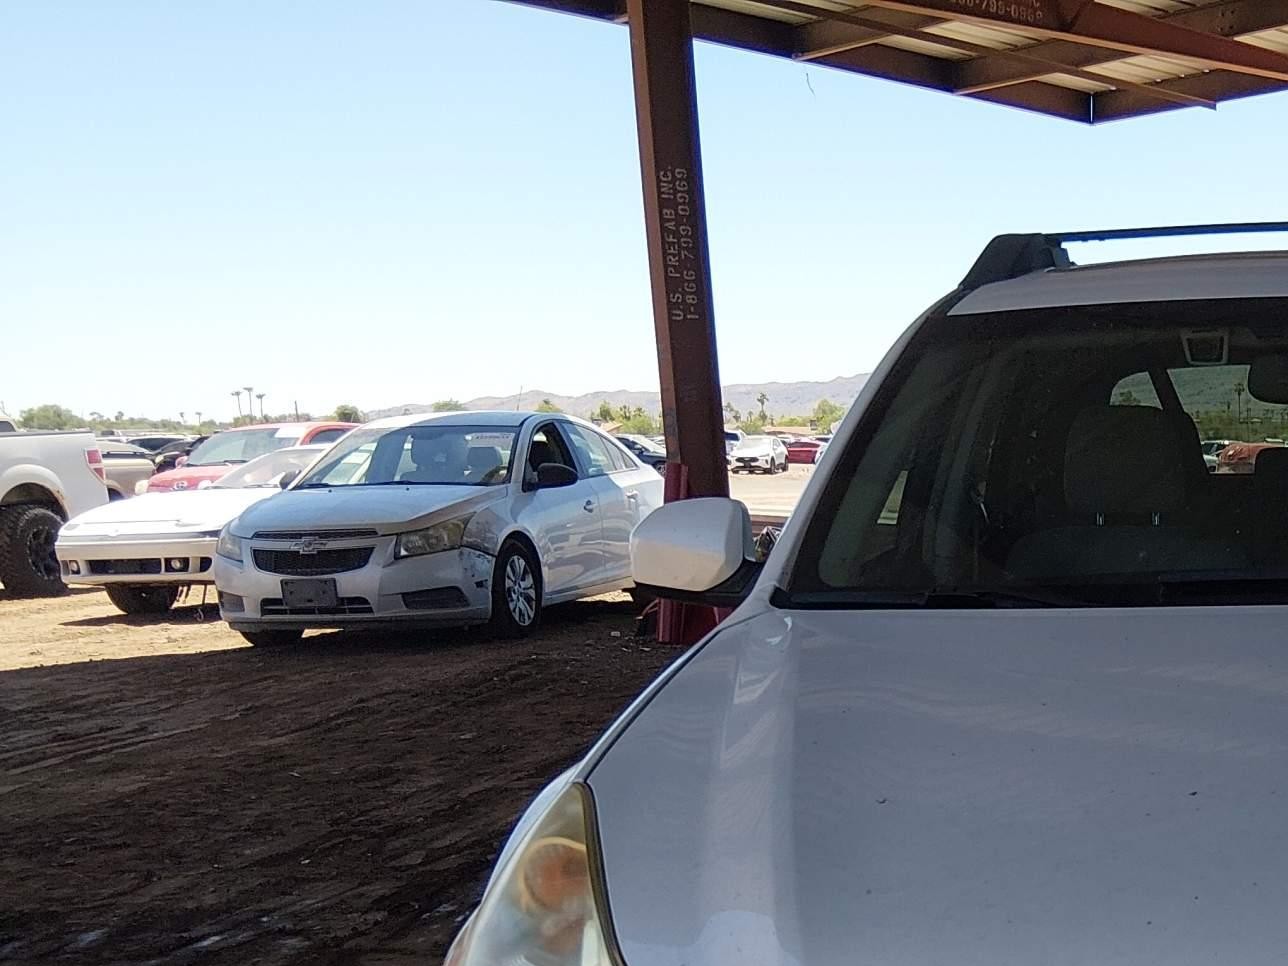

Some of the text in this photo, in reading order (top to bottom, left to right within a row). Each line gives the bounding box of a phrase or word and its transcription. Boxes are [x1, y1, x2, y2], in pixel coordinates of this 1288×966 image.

[659, 166, 684, 320] U.S. PREFAB INC.
